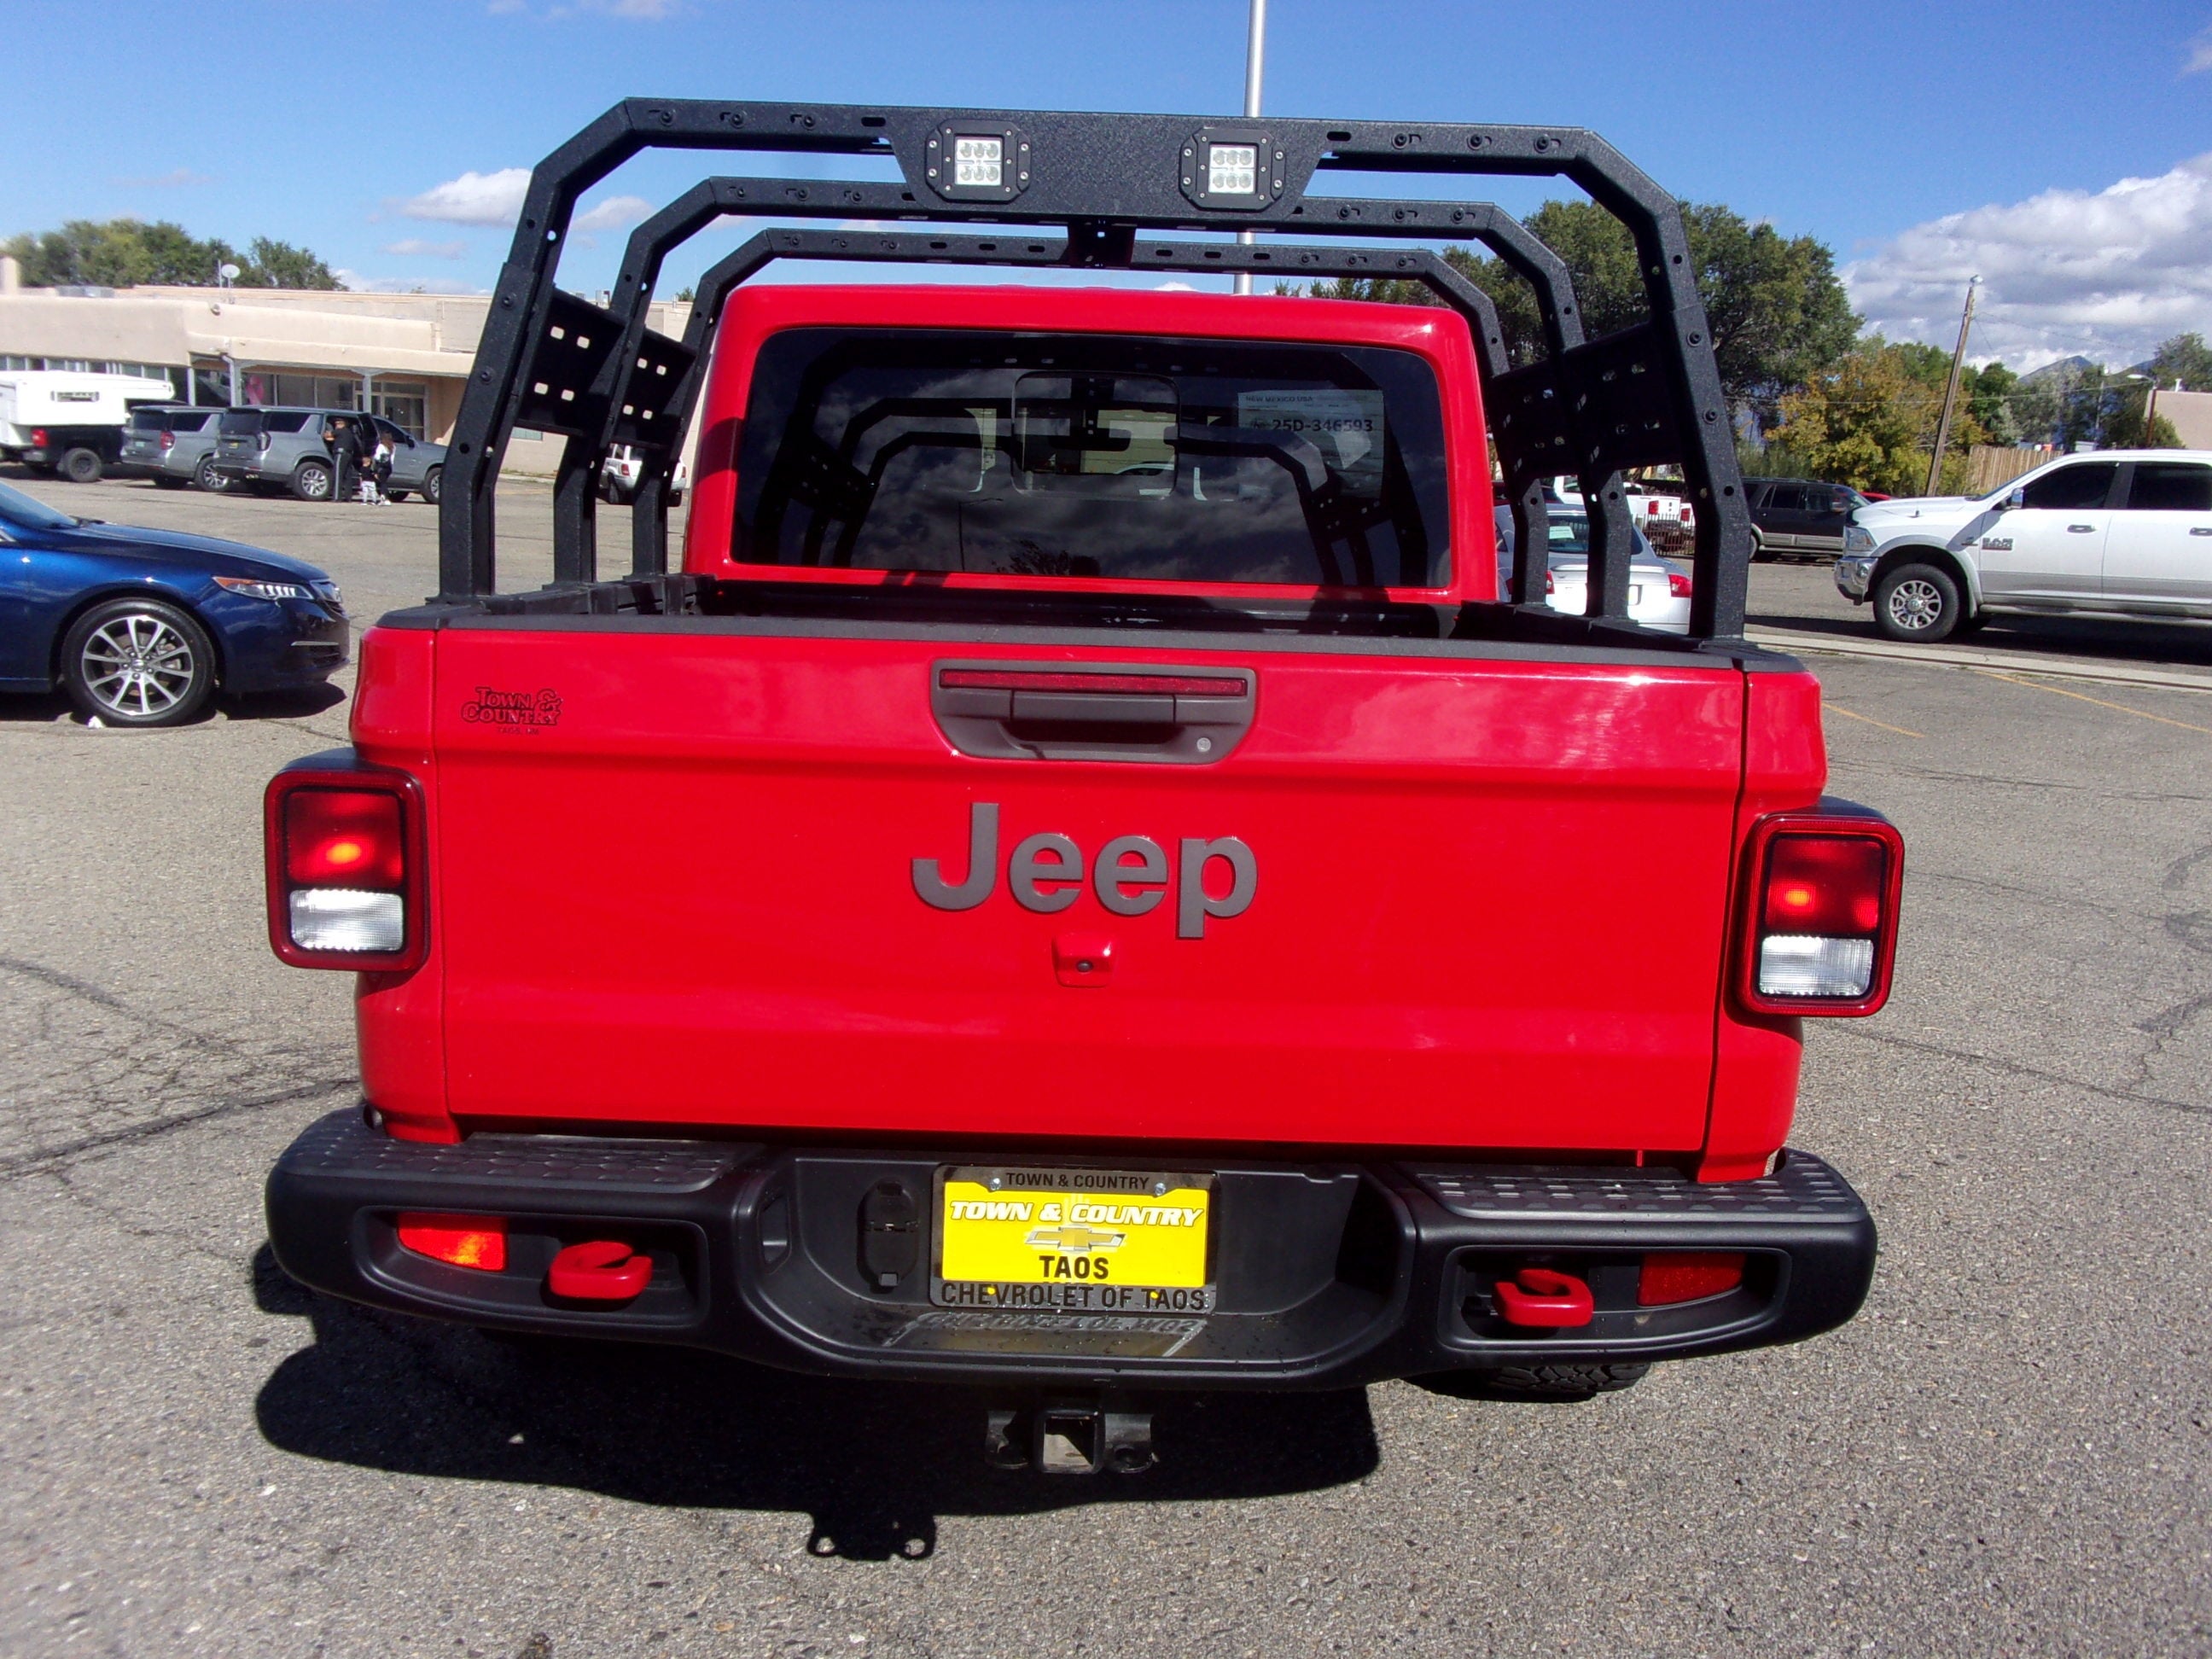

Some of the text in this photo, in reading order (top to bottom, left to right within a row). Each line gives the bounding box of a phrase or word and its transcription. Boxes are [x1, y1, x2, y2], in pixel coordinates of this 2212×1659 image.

[1272, 418, 1373, 432] 25D-346593
[475, 686, 533, 709] TOWN
[461, 701, 557, 725] COUNTRY
[911, 802, 1259, 939] Jeep
[1005, 1172, 1150, 1190] TOWN & COUNTRY
[950, 1200, 1203, 1227] TOWN & COUNTRY
[1039, 1255, 1109, 1279] TAOS
[940, 1282, 1205, 1311] CHEVROLET OF TAOS
